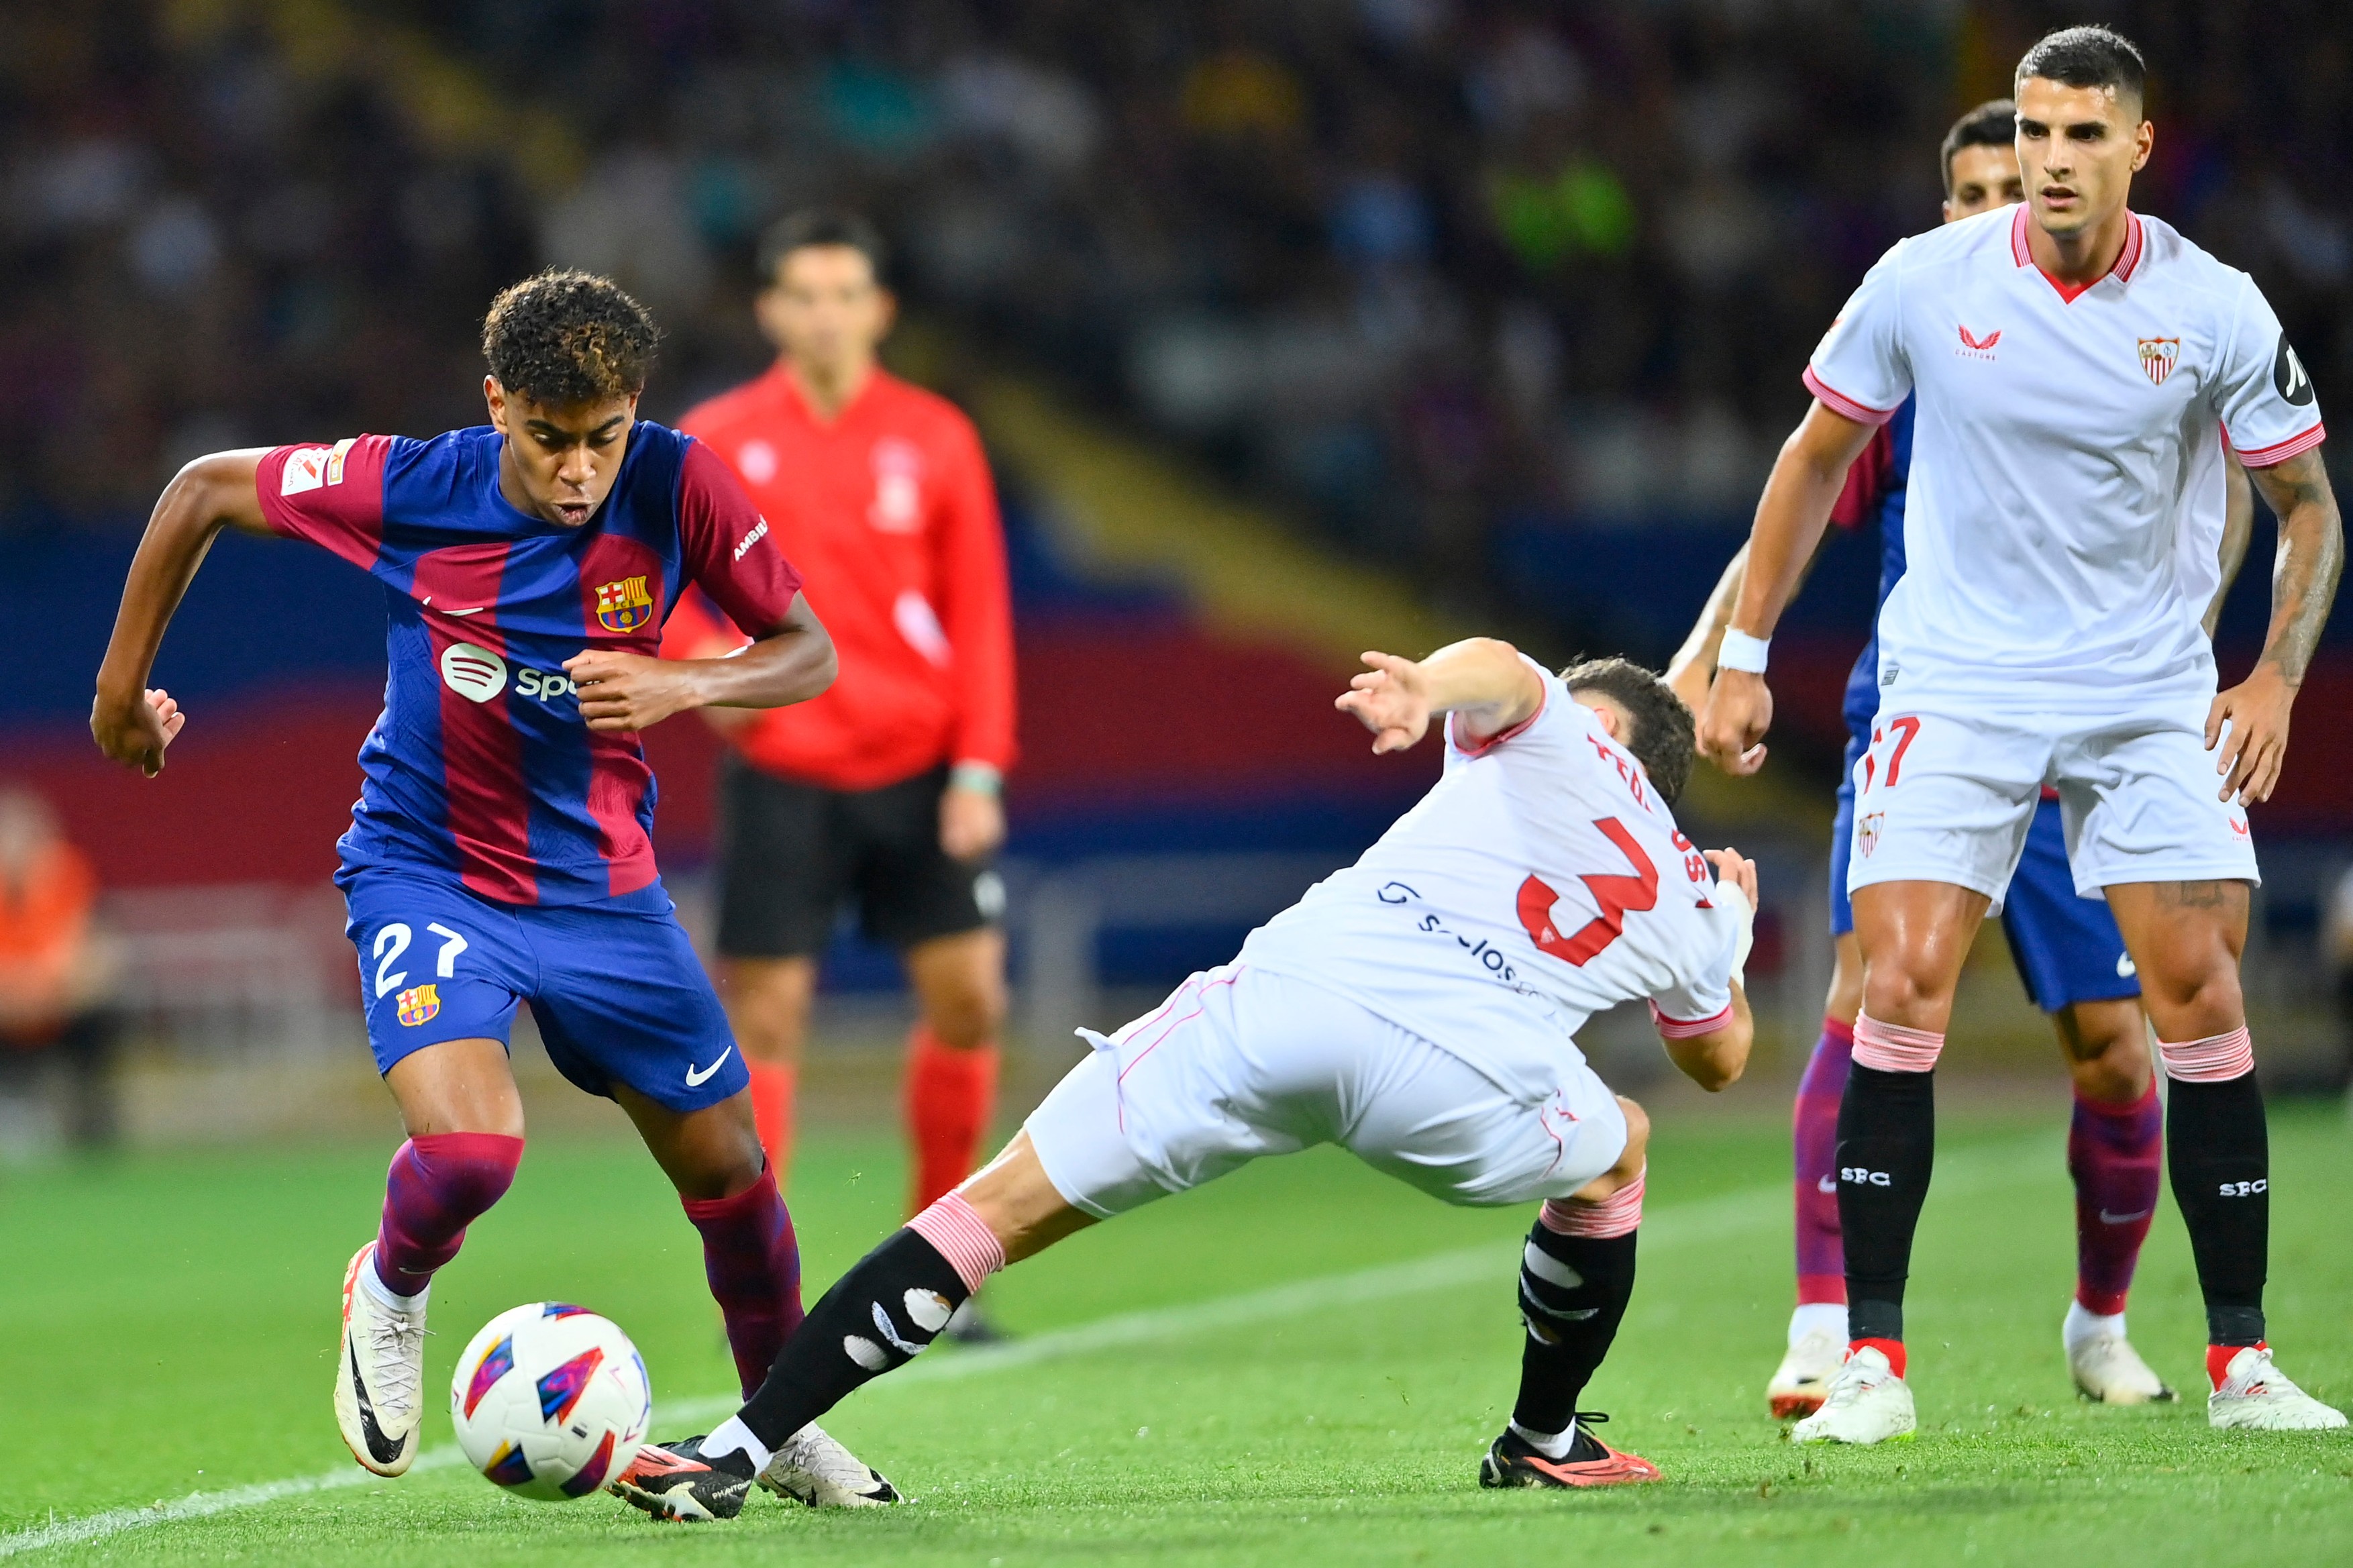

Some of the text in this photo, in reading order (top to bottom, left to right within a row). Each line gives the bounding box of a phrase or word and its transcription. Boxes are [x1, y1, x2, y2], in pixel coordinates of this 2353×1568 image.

[1516, 815, 1659, 968] 3
[373, 922, 468, 999] 27
[1840, 1167, 1891, 1187] SFC
[2219, 1178, 2267, 1197] SFC
